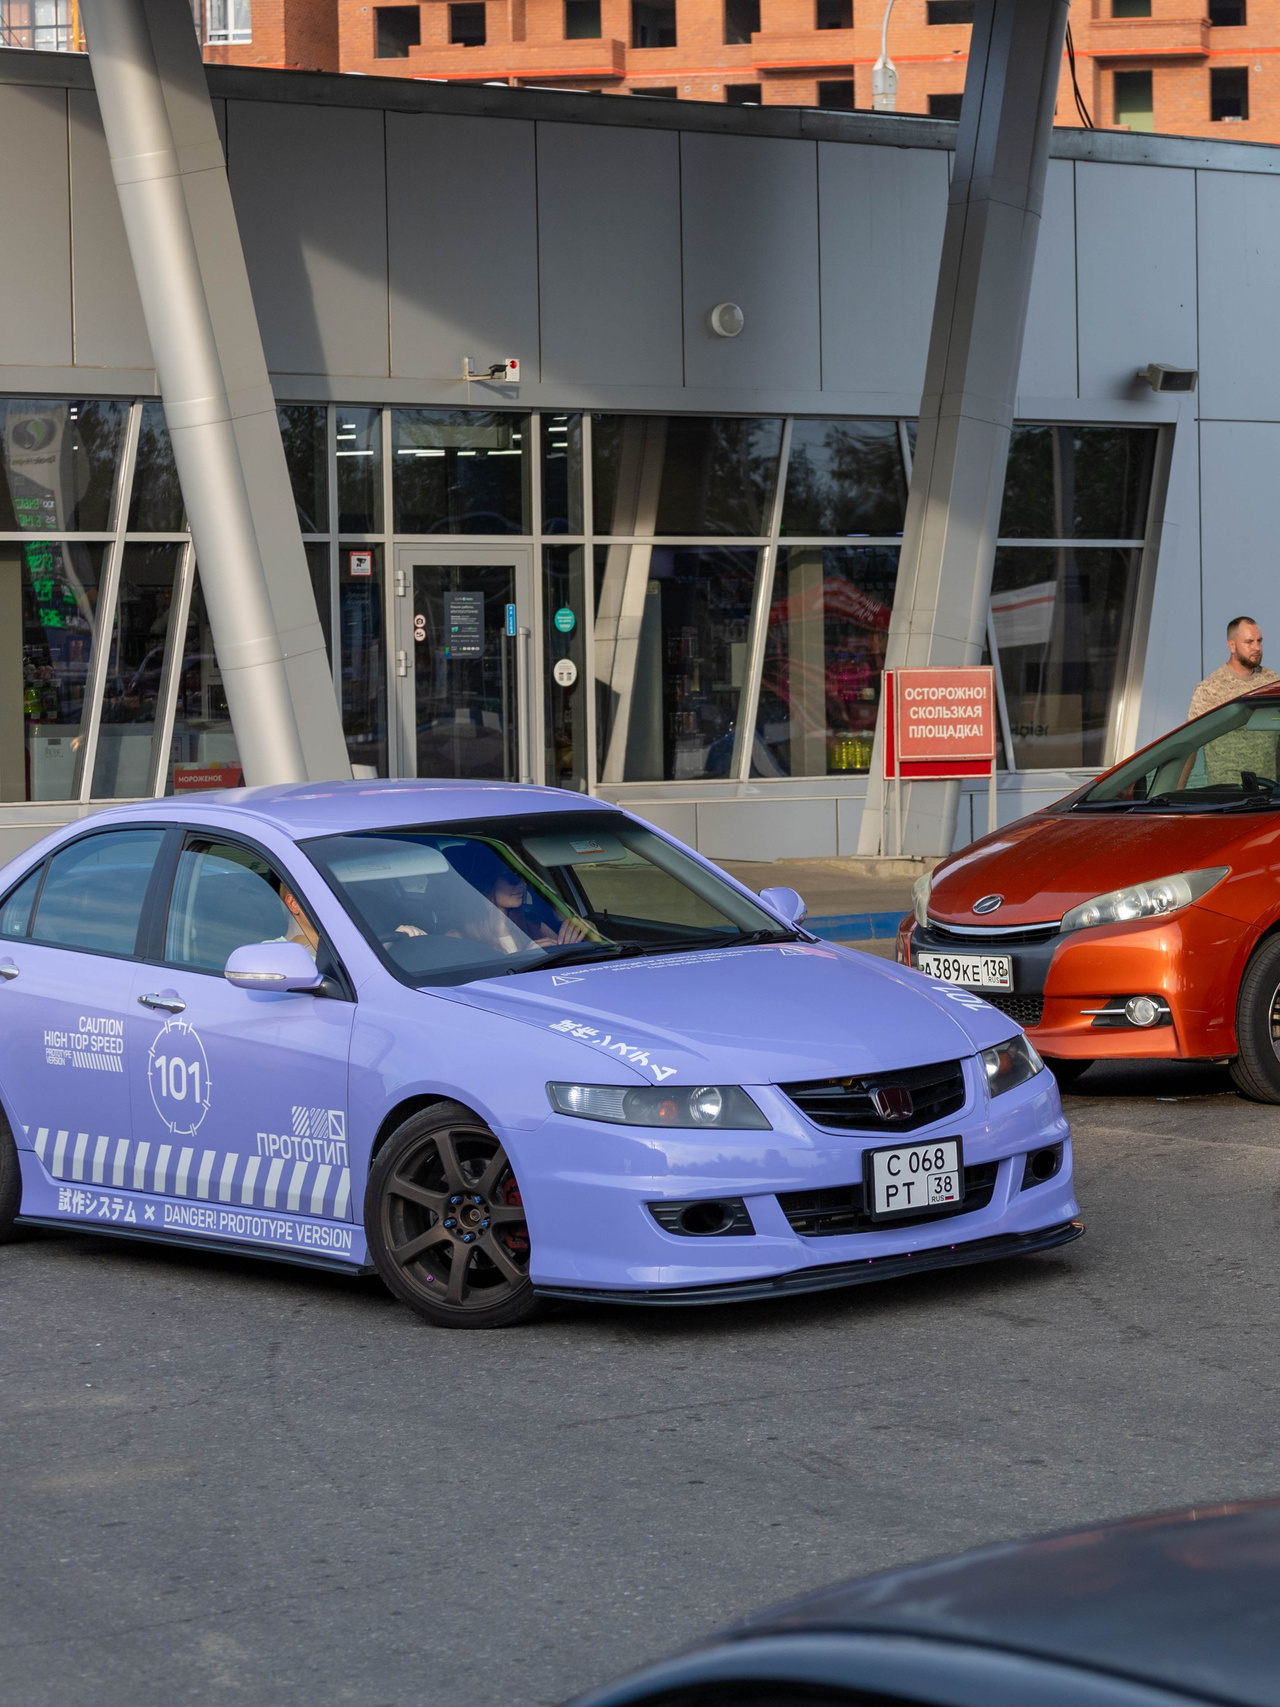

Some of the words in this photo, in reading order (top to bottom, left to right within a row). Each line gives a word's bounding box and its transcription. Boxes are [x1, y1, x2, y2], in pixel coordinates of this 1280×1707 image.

[904, 687, 987, 700] ОСТОРОЖНО!
[909, 706, 982, 719] СКОЛЬЗКАЯ
[908, 724, 984, 740] ПЛОЩАДКА!
[178, 774, 223, 783] МОРОЖЕНОЕ
[925, 957, 981, 982] А389КЕ
[983, 959, 1005, 977] 138
[79, 1016, 124, 1036] CAUTION
[44, 1030, 68, 1048] HIGH
[69, 1033, 89, 1050] TOP
[90, 1035, 124, 1054] SPEED
[45, 1047, 72, 1059] PROTOTYPE
[46, 1056, 66, 1066] VERSION
[154, 1055, 201, 1104] 101
[256, 1132, 349, 1167] ПРОТОТИП
[909, 1148, 945, 1174] 068
[934, 1175, 953, 1194] 38
[886, 1181, 915, 1208] РТ
[931, 1194, 945, 1203] RUS
[58, 1187, 137, 1224] 試作システム
[163, 1203, 217, 1230] DANGER!
[219, 1210, 294, 1242] PROTOTYPE
[295, 1223, 353, 1250] VERSION
